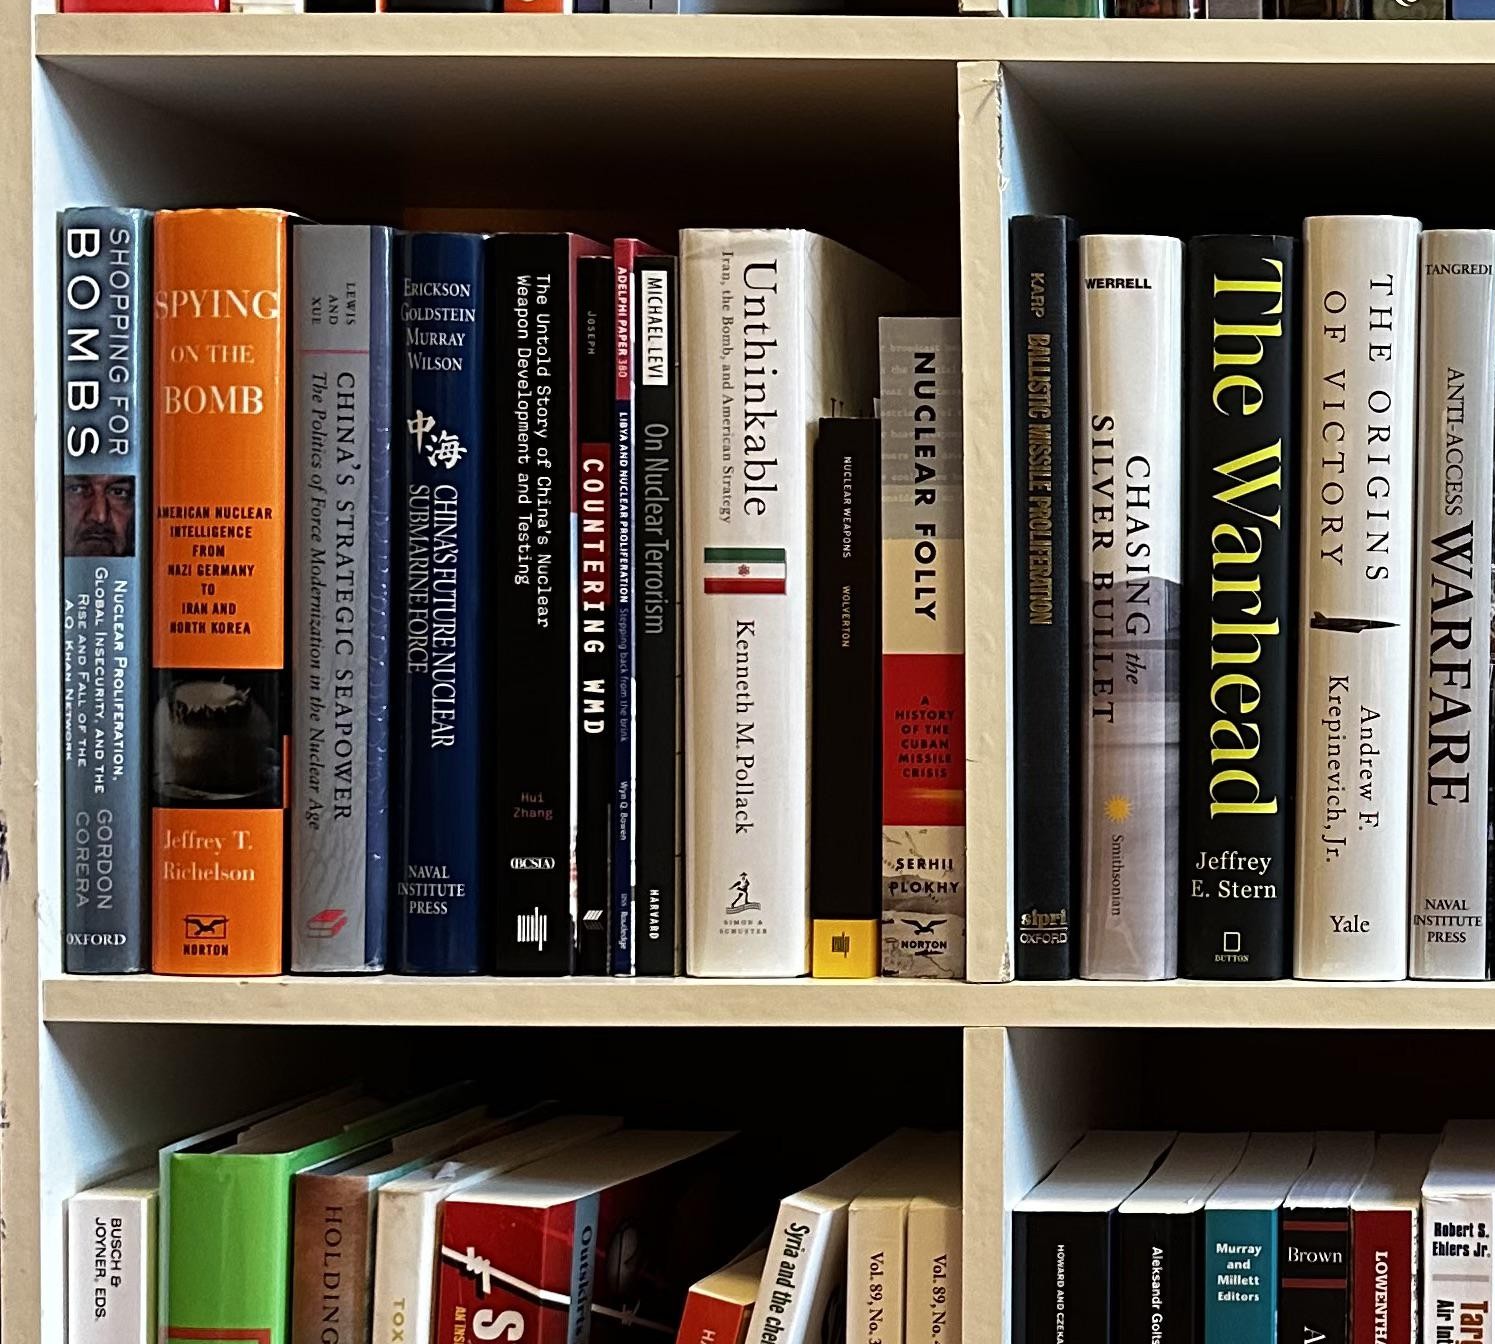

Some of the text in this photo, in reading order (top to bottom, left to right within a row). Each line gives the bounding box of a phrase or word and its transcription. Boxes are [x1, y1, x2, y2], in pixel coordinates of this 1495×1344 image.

[68, 228, 98, 457] BOMBS
[106, 228, 130, 455] SHOPPING FOR
[742, 260, 779, 516] Unthinkable
[1321, 291, 1348, 566] OF VICTORY
[1366, 275, 1392, 581] THE ORIGINS
[333, 372, 361, 822] CHINA'S STRATEGIC SEAPOWER
[583, 458, 604, 734] COUNTERING WMD
[643, 424, 669, 635] On Nuclear Terrorism
[913, 352, 937, 621] NUCLEAR FOLLY
[1091, 415, 1115, 724] SILVER BULLET
[1125, 455, 1150, 685] CHASING the
[1209, 257, 1283, 820] The Warhead
[1427, 368, 1474, 807] ANTI-ACCESS WARFARE
[74, 812, 90, 908] CORERA
[96, 809, 112, 910] GORDON
[649, 890, 660, 939] HARVARD
[1331, 916, 1370, 933] Yale
